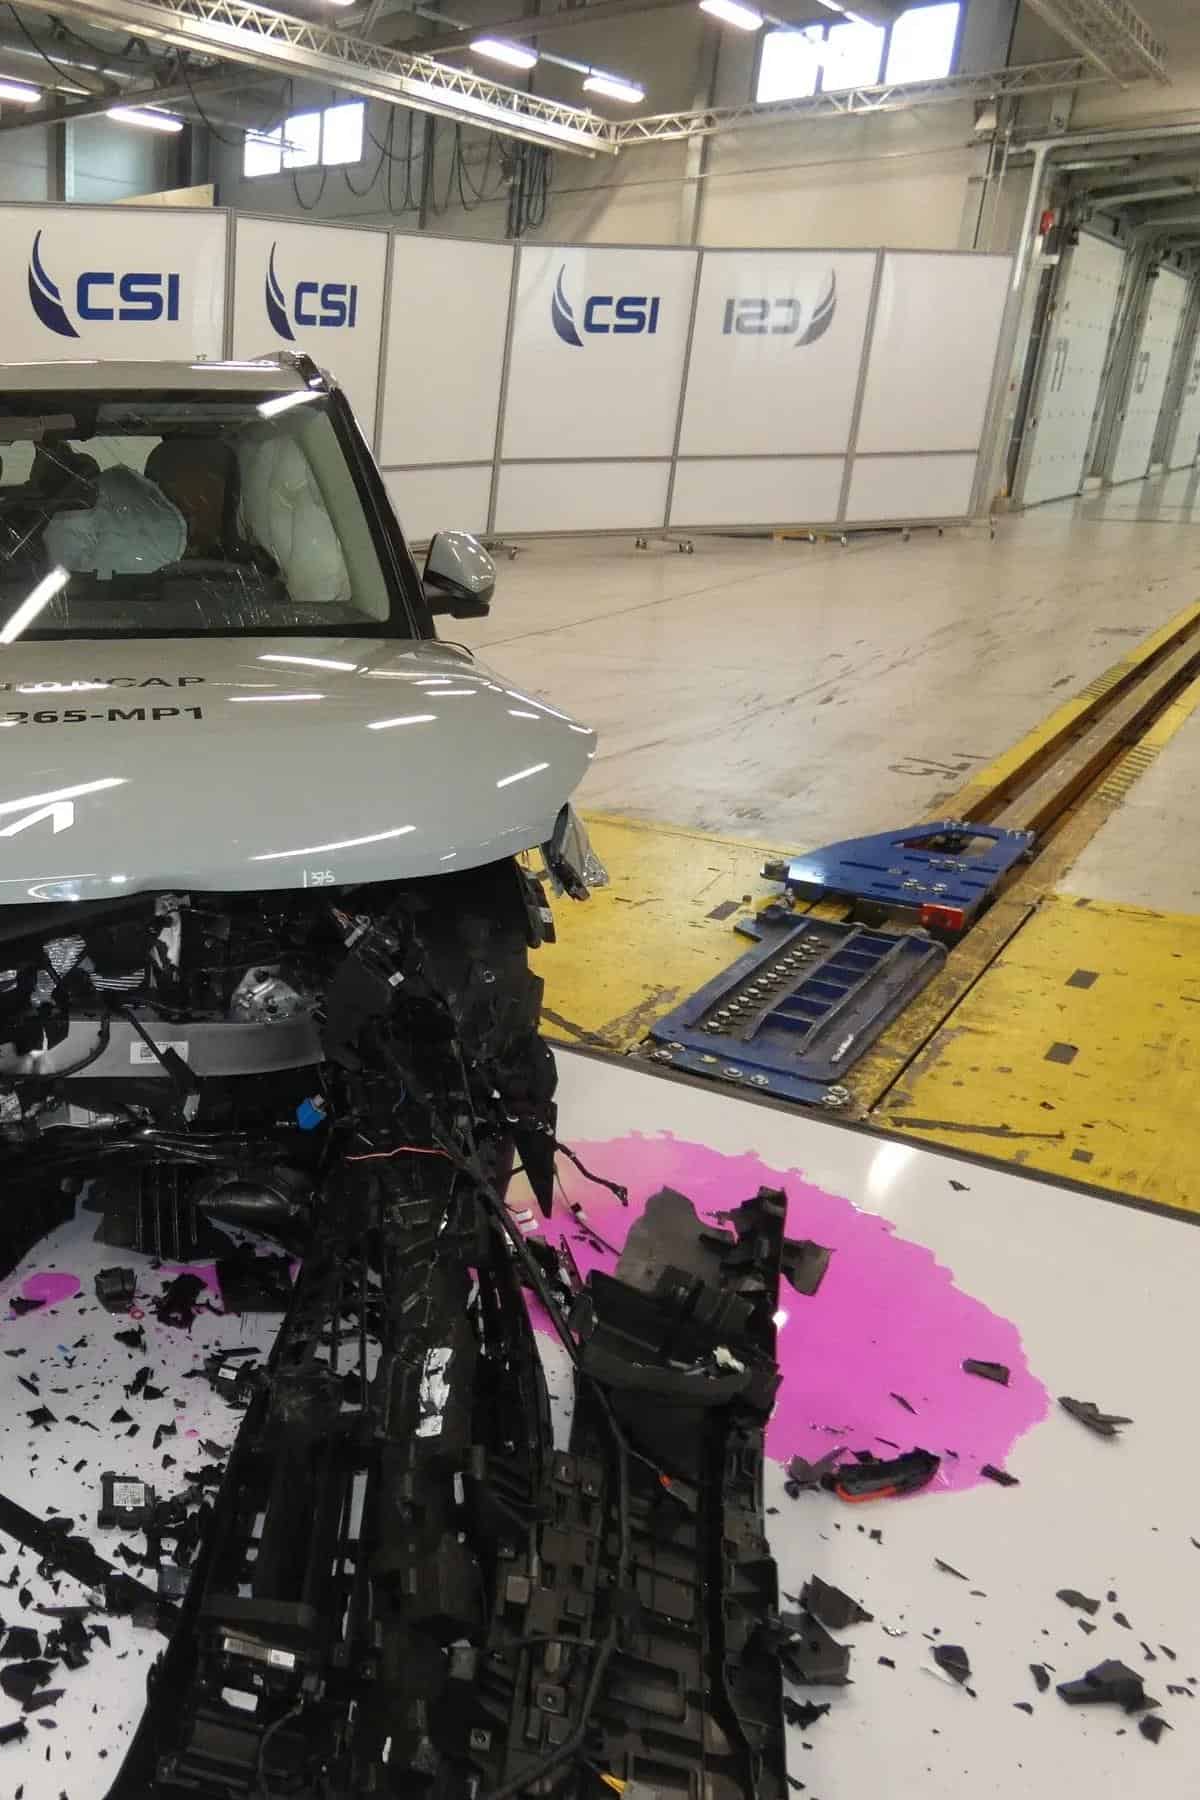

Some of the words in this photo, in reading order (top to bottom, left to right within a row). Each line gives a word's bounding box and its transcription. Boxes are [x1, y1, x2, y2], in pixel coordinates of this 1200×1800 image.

[77, 272, 180, 321] CSI
[294, 281, 357, 328] CSI
[584, 295, 659, 334] CSI
